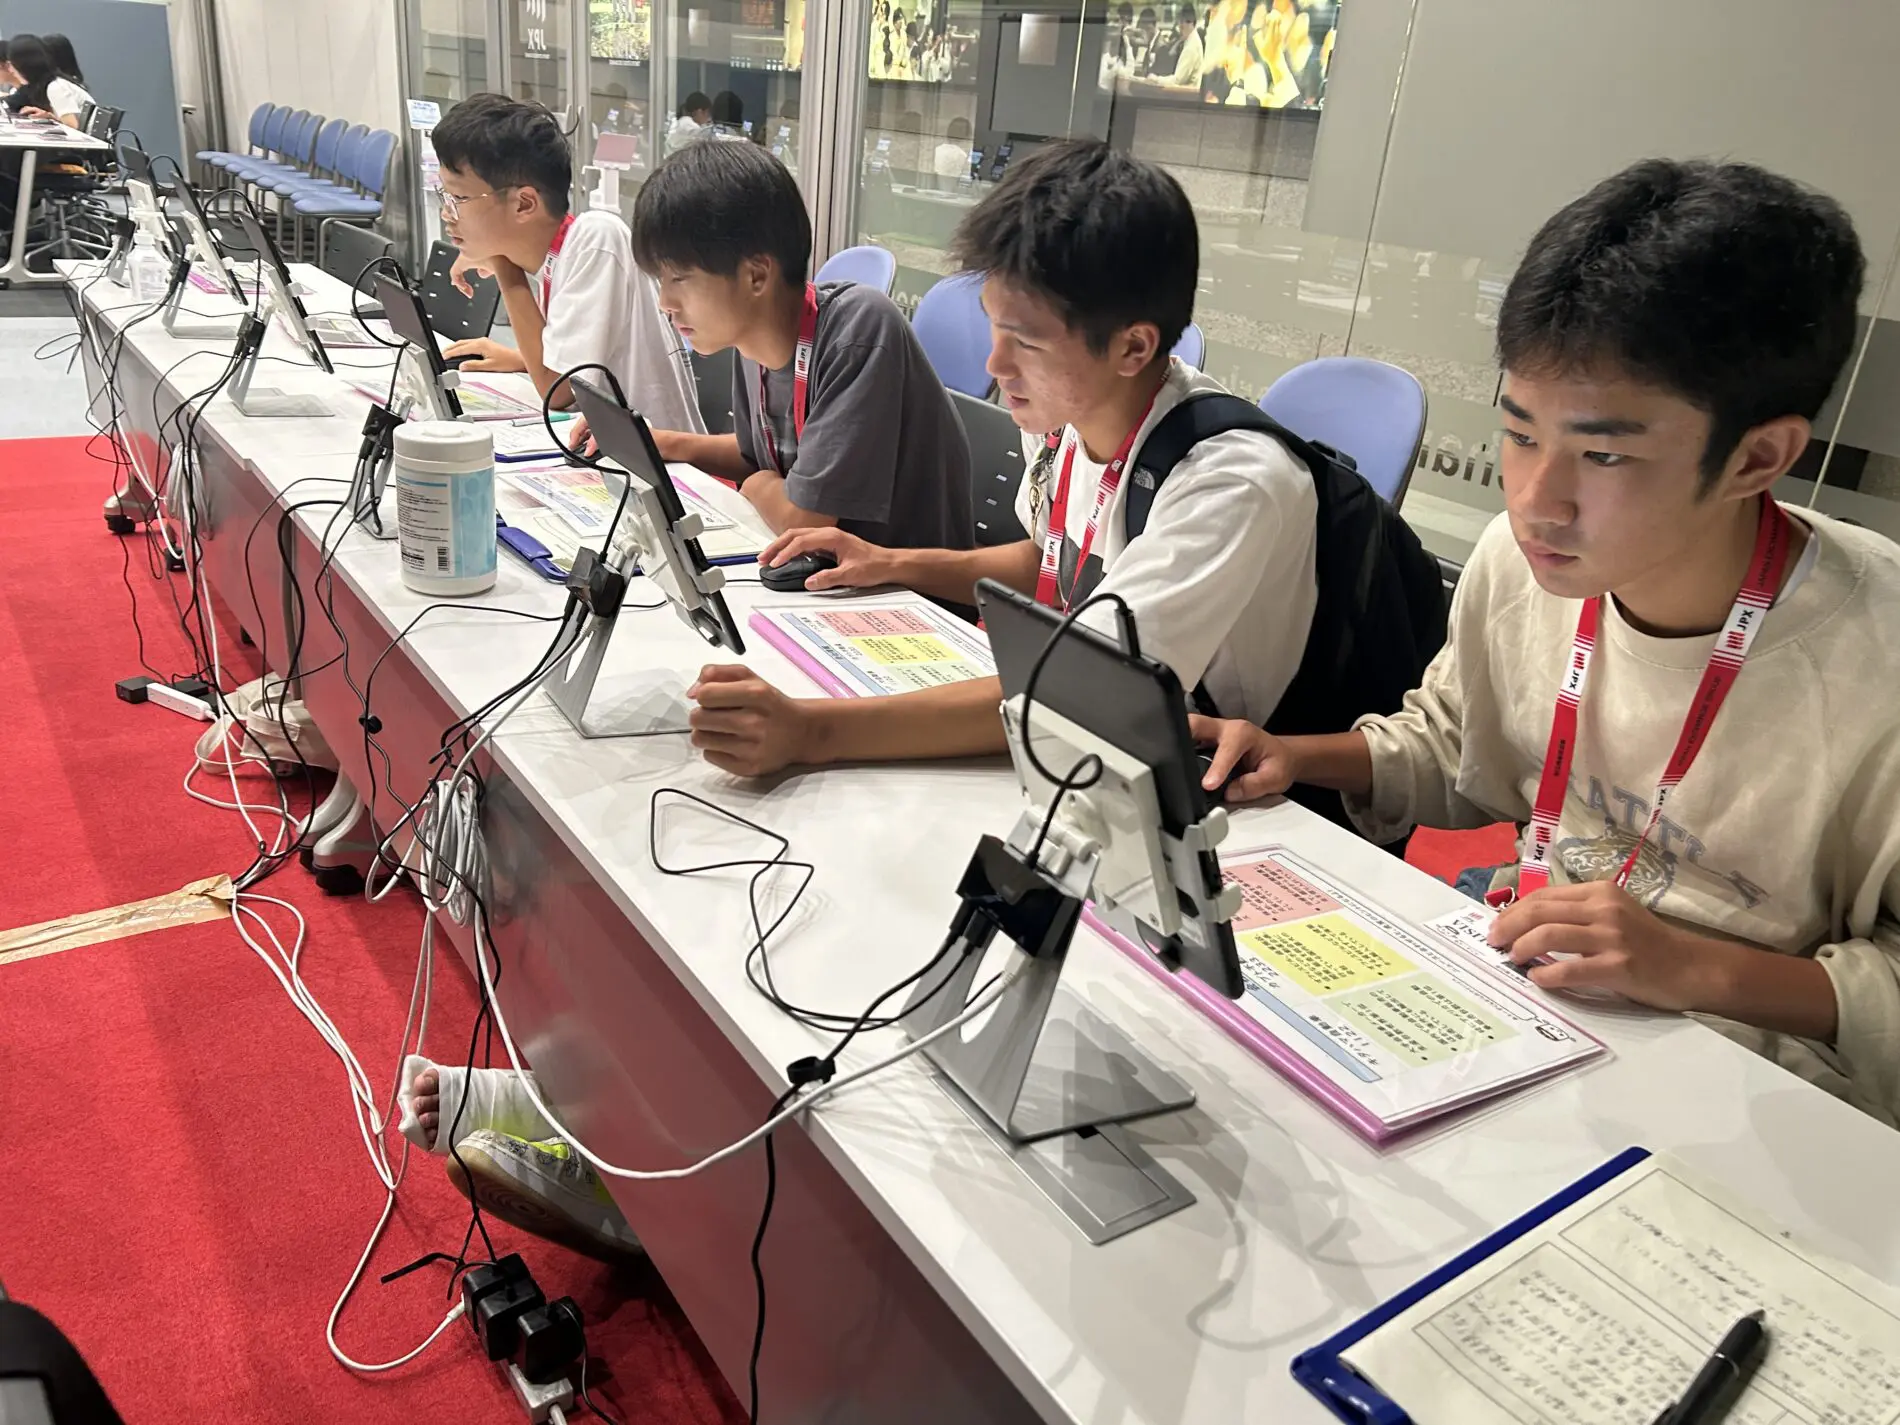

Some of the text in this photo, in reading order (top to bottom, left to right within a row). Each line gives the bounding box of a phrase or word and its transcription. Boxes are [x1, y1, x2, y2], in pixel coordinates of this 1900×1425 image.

[1092, 504, 1100, 520] JPX
[1739, 609, 1755, 631] JPX
[1567, 670, 1579, 690] JPX
[1658, 788, 1667, 806] JPX
[1534, 844, 1546, 863] JPX
[1247, 956, 1279, 977] 2233
[1335, 1024, 1370, 1046] 1122
